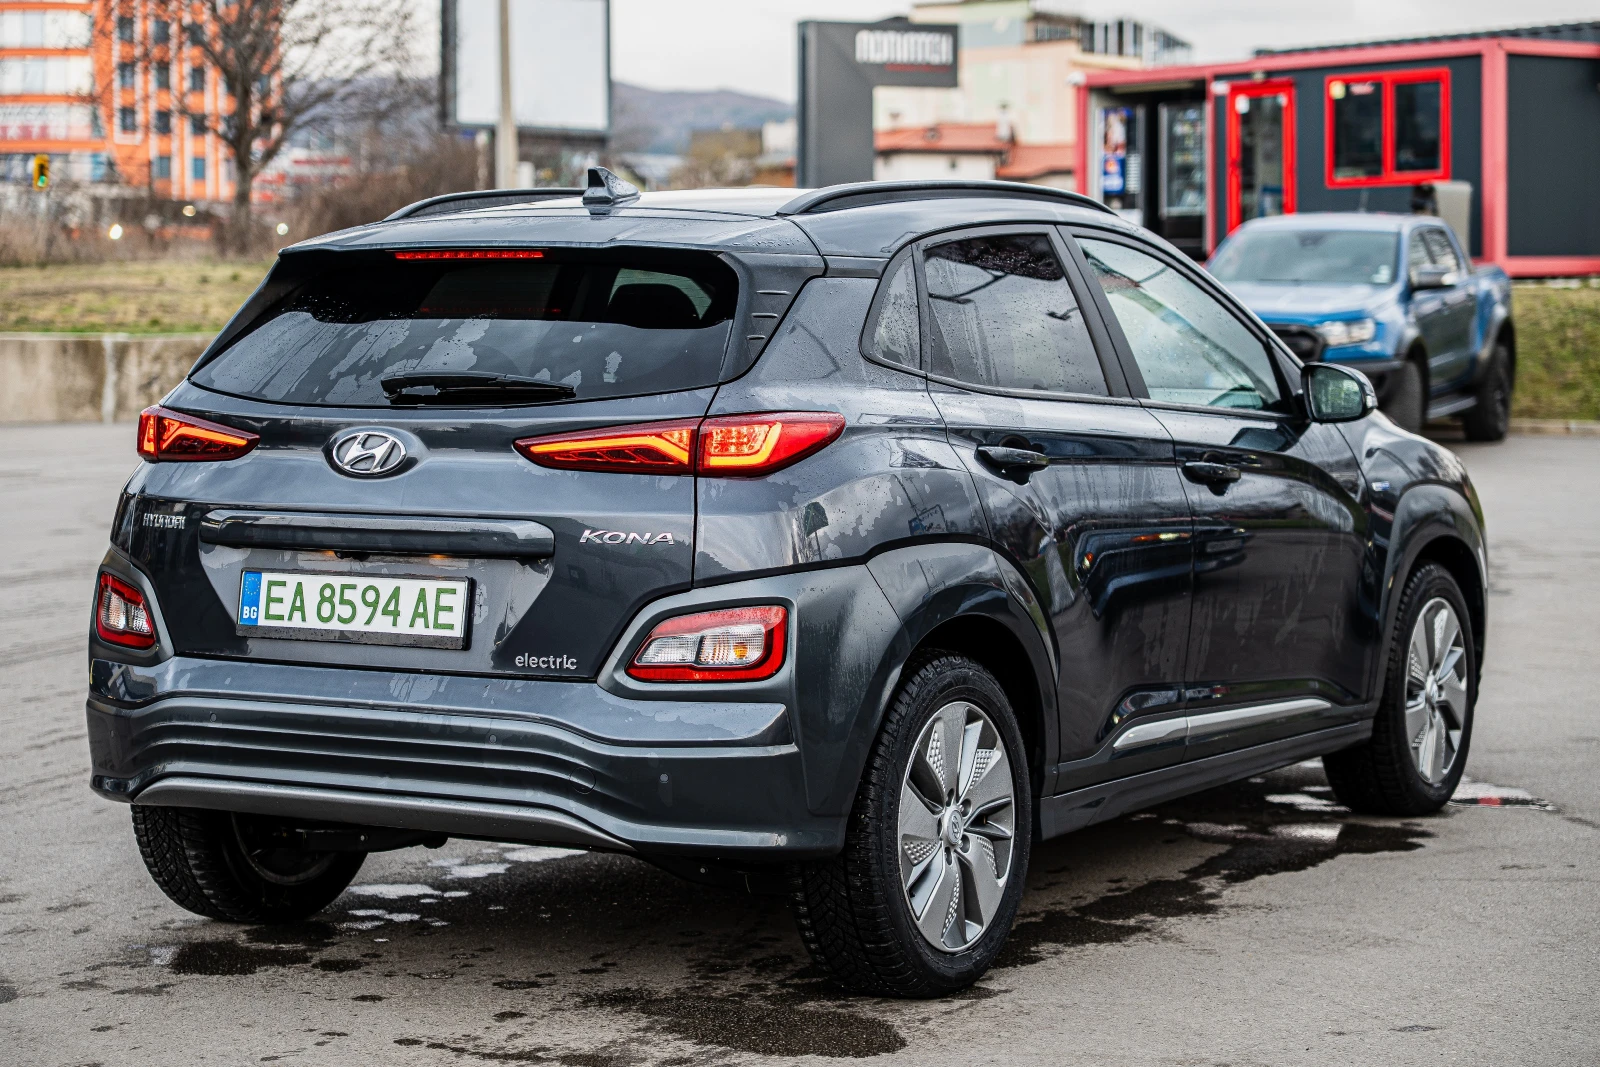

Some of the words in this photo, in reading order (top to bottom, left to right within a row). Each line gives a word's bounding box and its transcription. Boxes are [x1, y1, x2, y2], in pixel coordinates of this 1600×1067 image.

[142, 512, 186, 530] HYUNDAI
[579, 529, 675, 545] KONA
[242, 606, 258, 619] BG
[264, 580, 307, 622] EA
[316, 582, 401, 627] 8594
[409, 587, 457, 630] AE
[515, 652, 577, 670] electric
